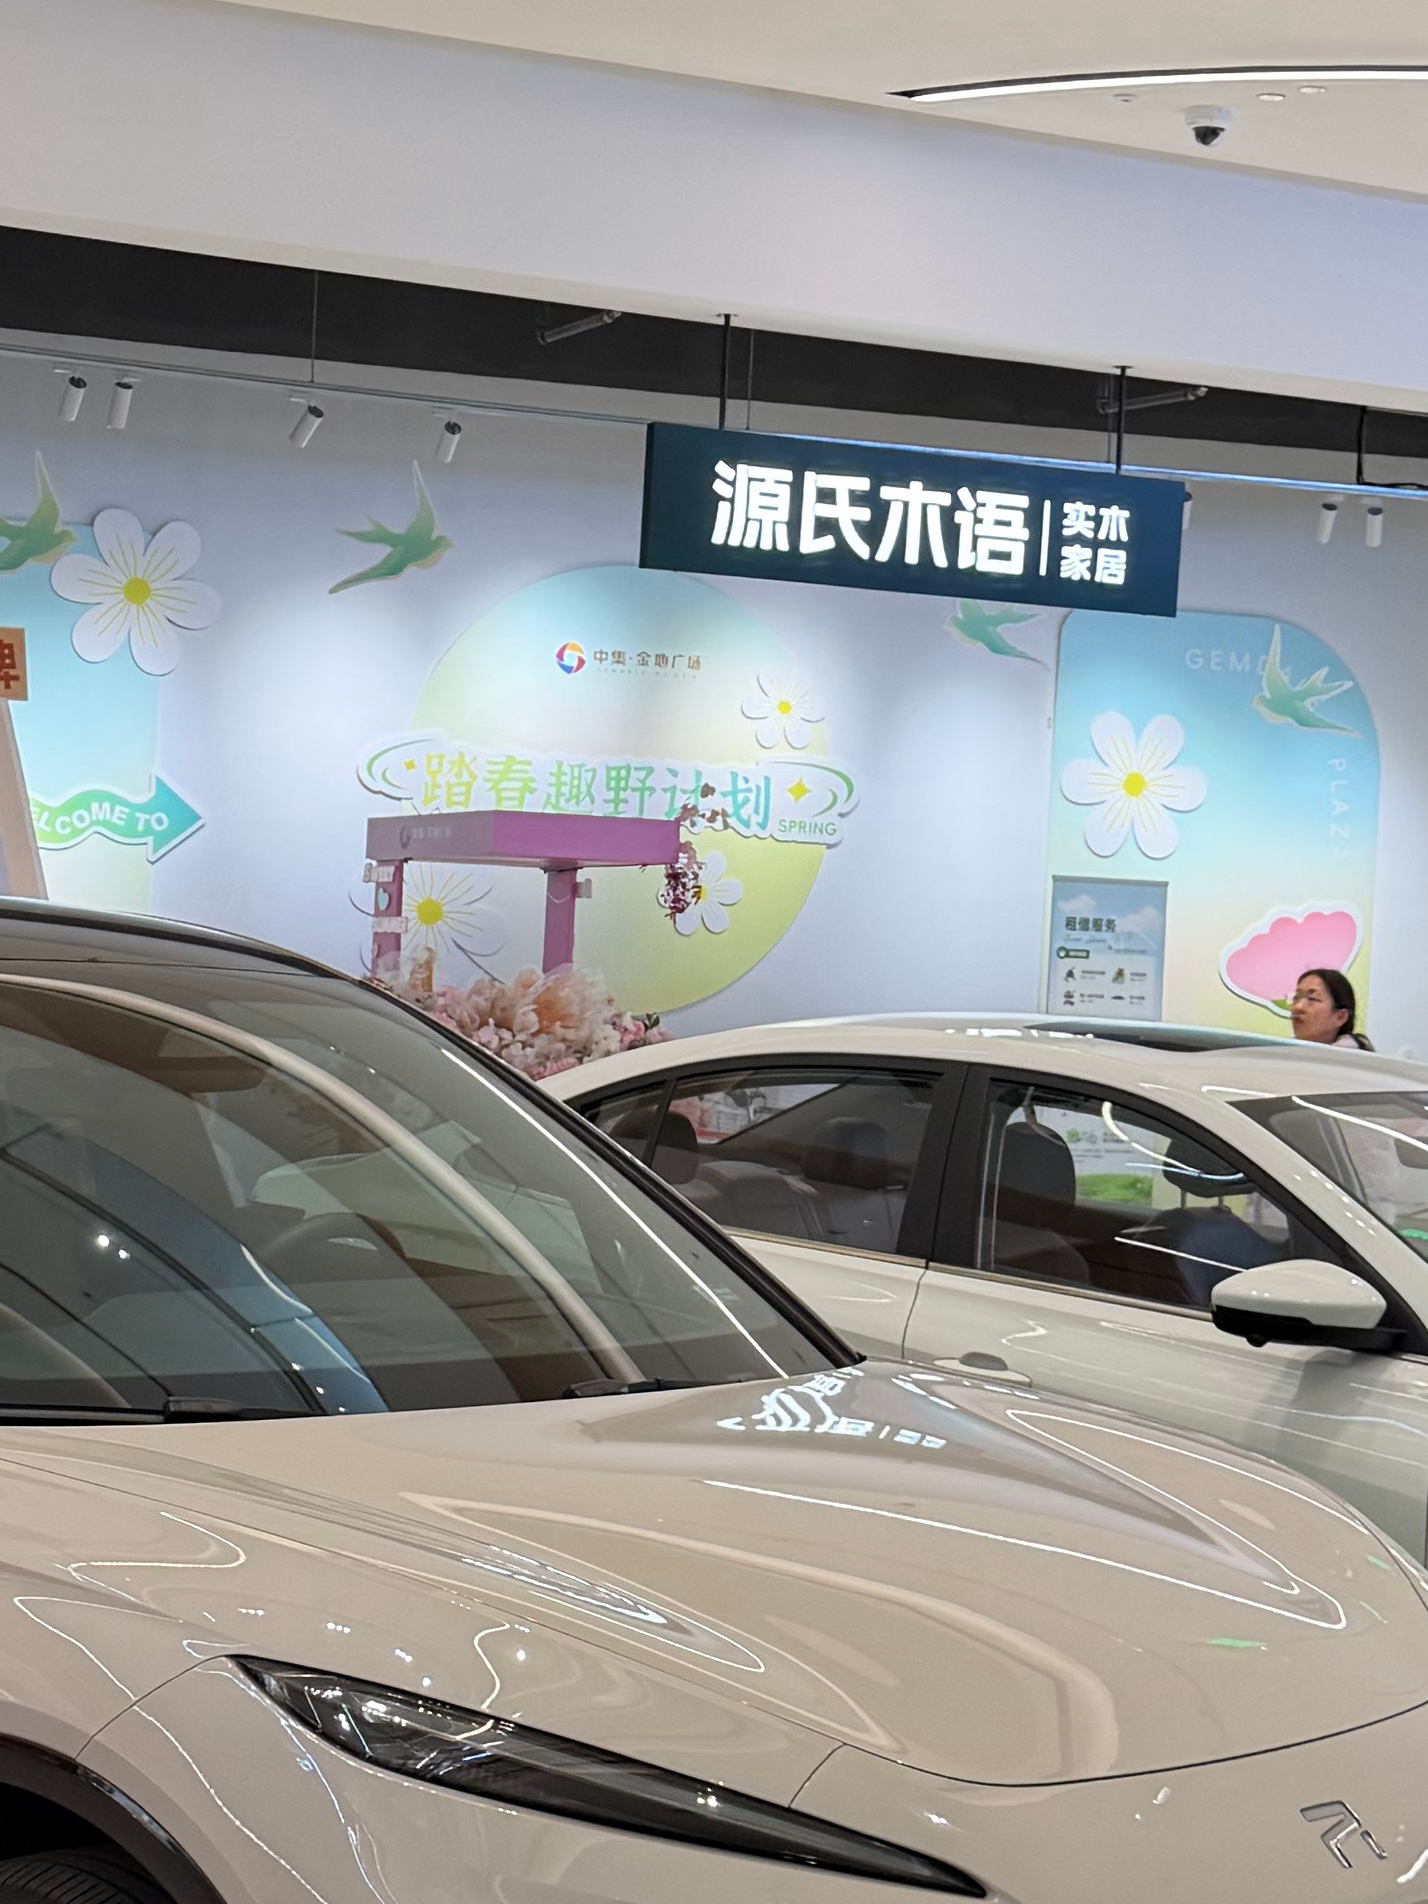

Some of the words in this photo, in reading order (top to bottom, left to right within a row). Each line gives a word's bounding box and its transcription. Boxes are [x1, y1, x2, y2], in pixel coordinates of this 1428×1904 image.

[710, 459, 1030, 577] 源氏木语
[1062, 500, 1131, 543] 实木
[1059, 545, 1128, 586] 家居
[419, 750, 772, 831] 踏春趣野计划
[135, 811, 169, 832] TO
[777, 817, 838, 836] SPRING
